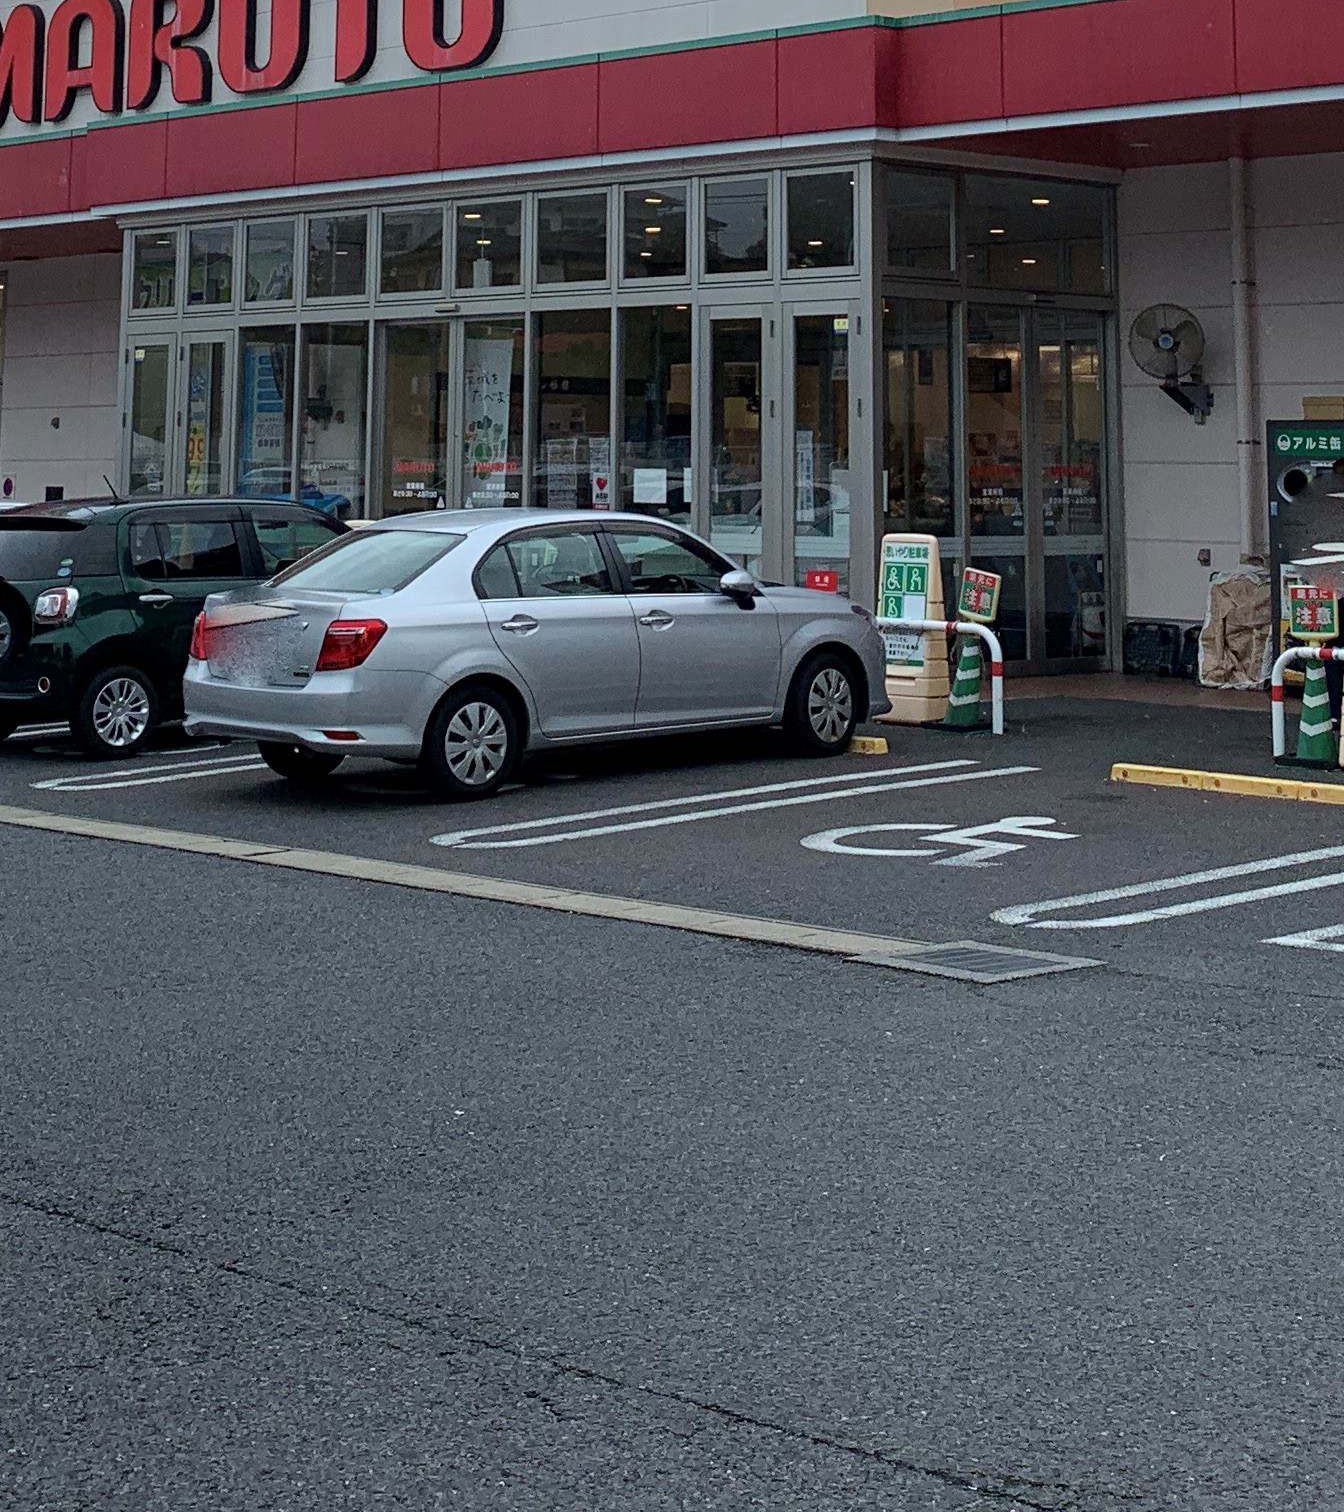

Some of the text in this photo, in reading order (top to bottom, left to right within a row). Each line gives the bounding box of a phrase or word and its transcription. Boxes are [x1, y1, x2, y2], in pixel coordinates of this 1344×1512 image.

[1293, 437, 1342, 451] アルミ缶
[965, 588, 992, 609] 注意
[1296, 606, 1332, 626] 注意
